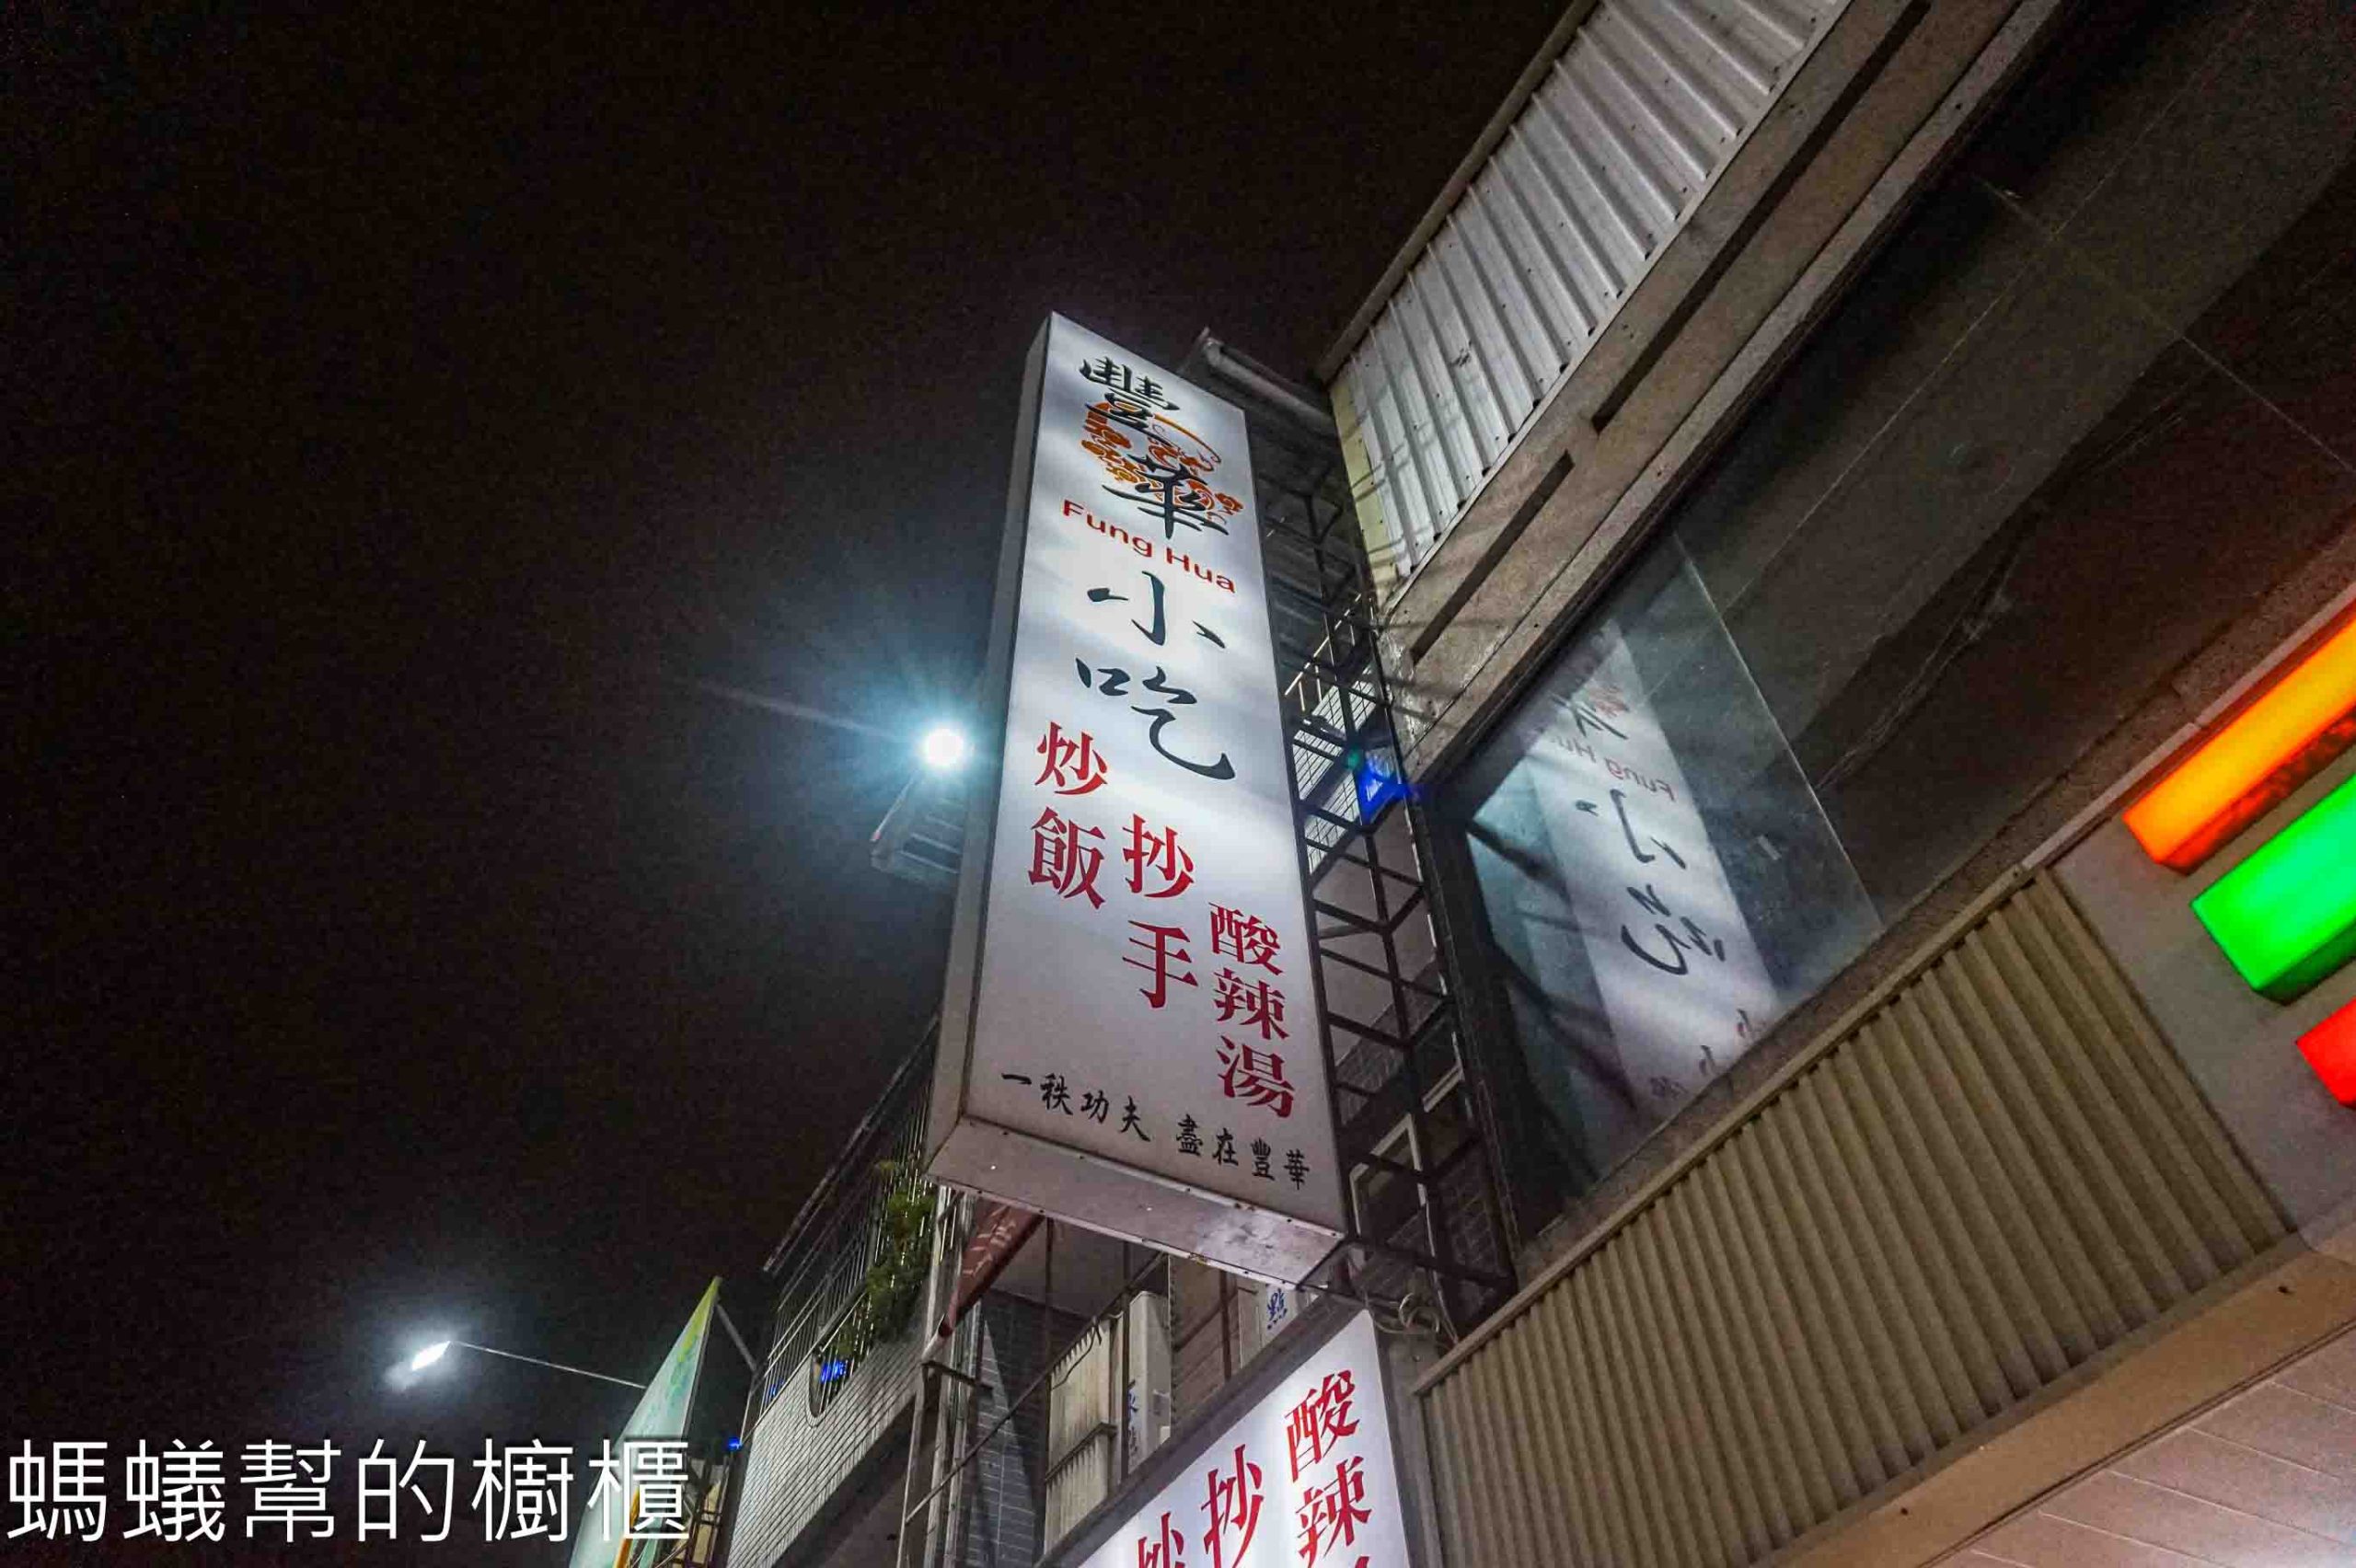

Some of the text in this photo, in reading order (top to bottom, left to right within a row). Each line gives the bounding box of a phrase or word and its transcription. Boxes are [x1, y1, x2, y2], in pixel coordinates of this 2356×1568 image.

[1063, 499, 1235, 594] Fung Hua
[1076, 571, 1235, 779] 小吃
[1028, 721, 1108, 909] 炒飯
[1123, 813, 1198, 1009] 抄手
[1208, 902, 1295, 1118] 酸辣湯
[1176, 1113, 1310, 1190] 盡在豐華
[1285, 1369, 1372, 1568] 酸辣
